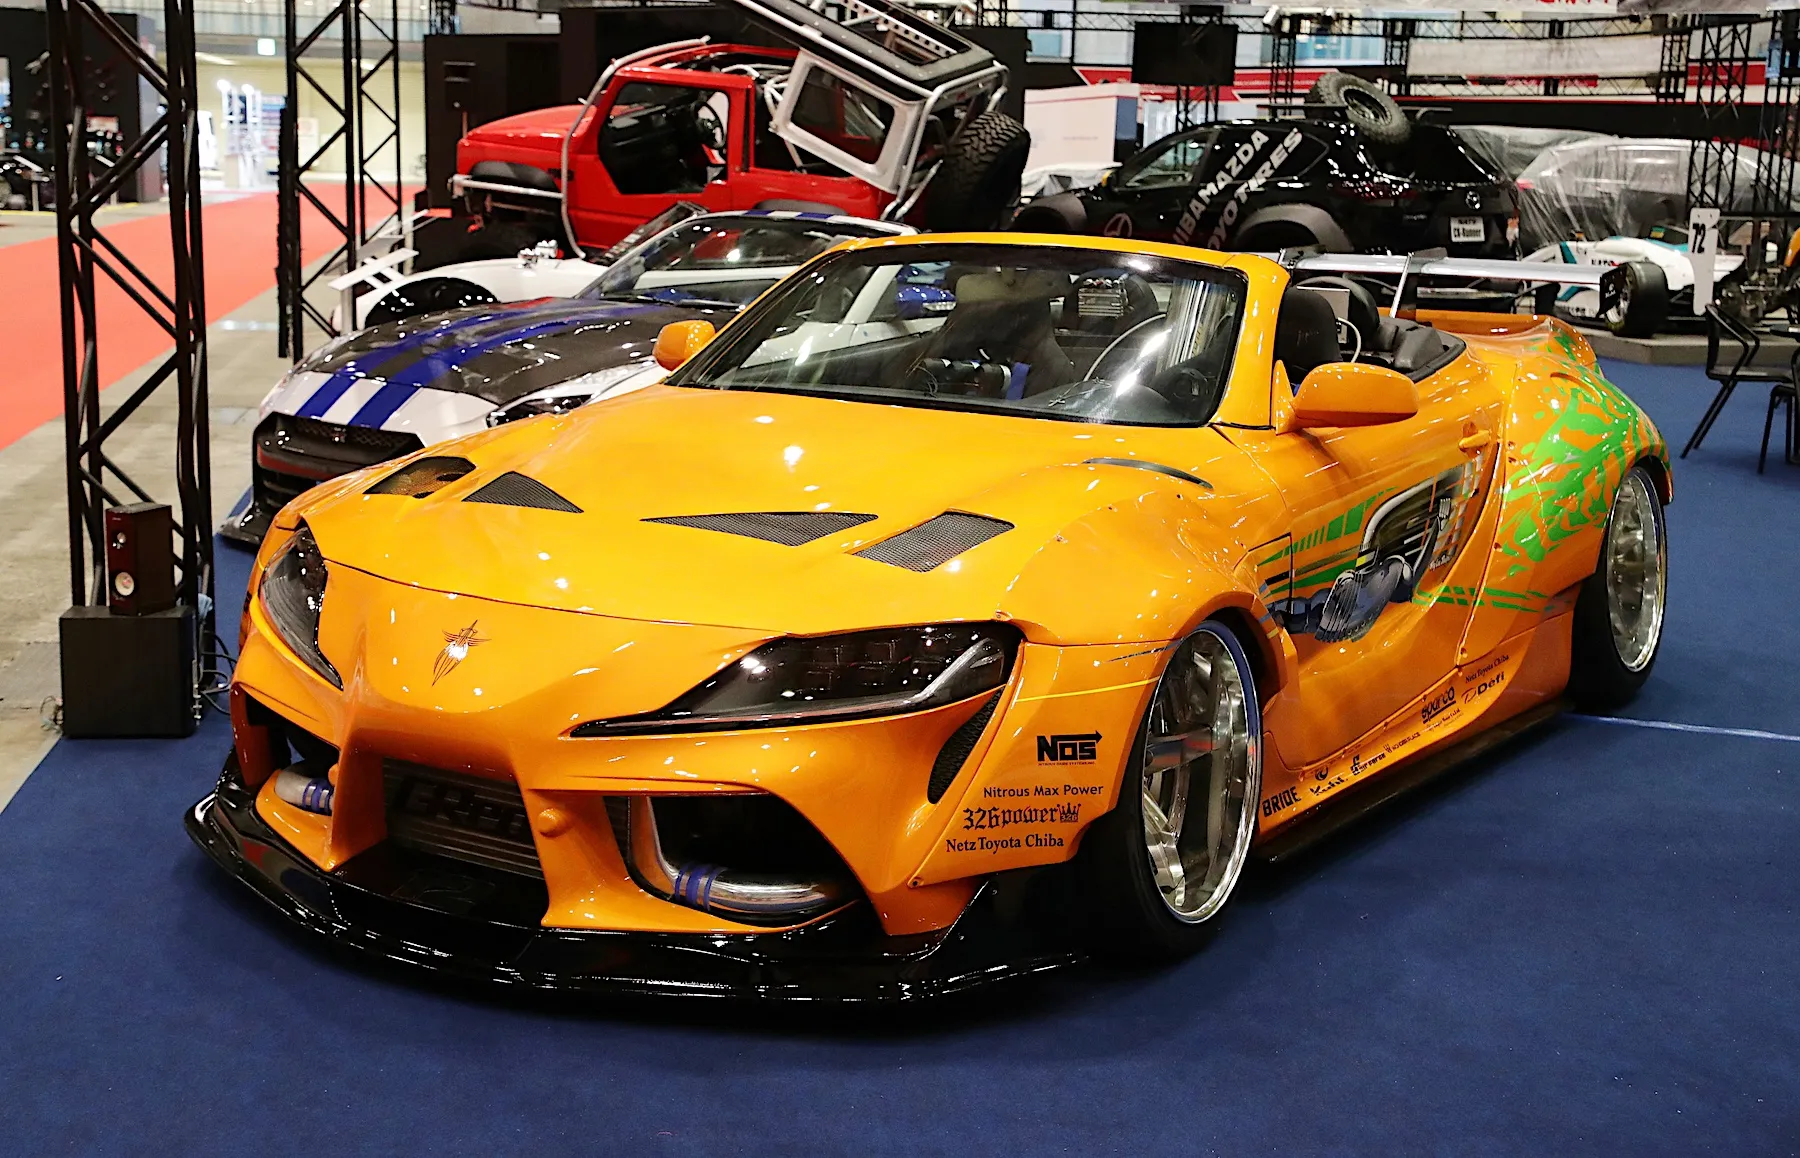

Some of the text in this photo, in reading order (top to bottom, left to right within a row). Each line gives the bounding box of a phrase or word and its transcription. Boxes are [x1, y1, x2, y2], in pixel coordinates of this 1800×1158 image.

[1234, 127, 1303, 204] TIRES
[1692, 223, 1706, 254] 72
[1421, 686, 1456, 722] sparco
[1036, 735, 1097, 762] NOS
[983, 784, 1104, 798] Nitrous Max Power
[1261, 786, 1302, 818] BRIDE
[963, 806, 1058, 830] 326power
[946, 833, 1064, 855] Netz Toyota Chiba
